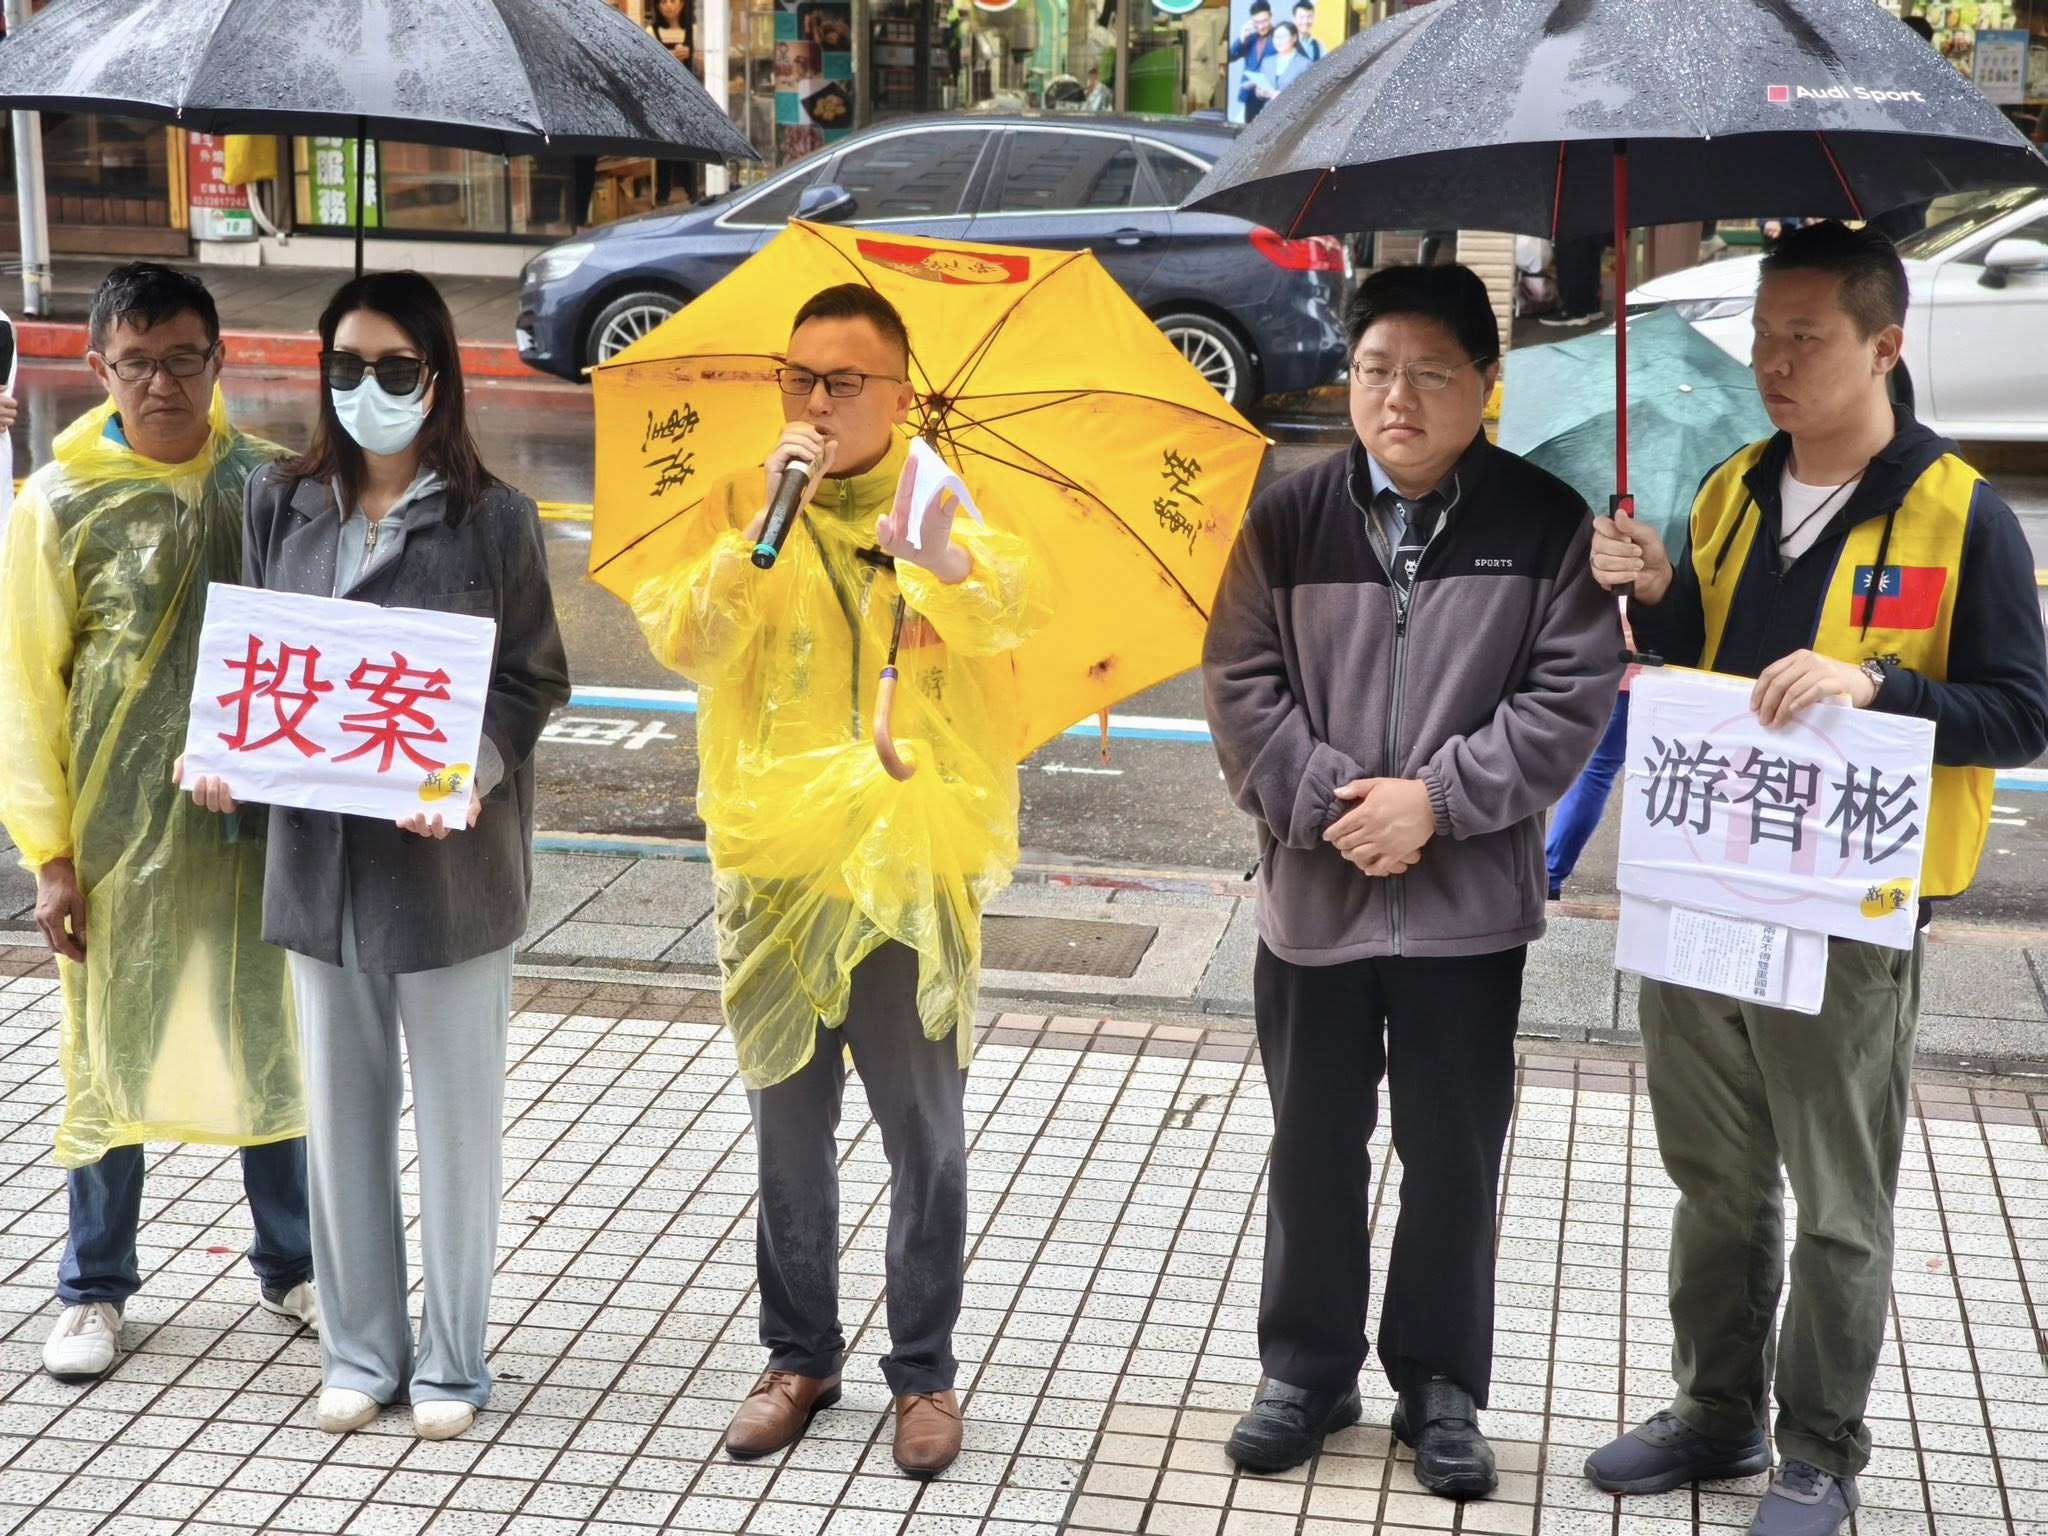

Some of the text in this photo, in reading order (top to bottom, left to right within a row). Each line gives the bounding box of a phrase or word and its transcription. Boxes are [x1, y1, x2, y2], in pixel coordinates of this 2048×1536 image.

[1796, 85, 1926, 103] Audi Sport
[315, 137, 347, 224] 服務
[1474, 558, 1513, 568] SPORTS
[216, 633, 452, 774] 投案
[424, 772, 463, 794] 新黨
[1641, 735, 1920, 865] 游智彬
[1864, 885, 1909, 912] 新黨
